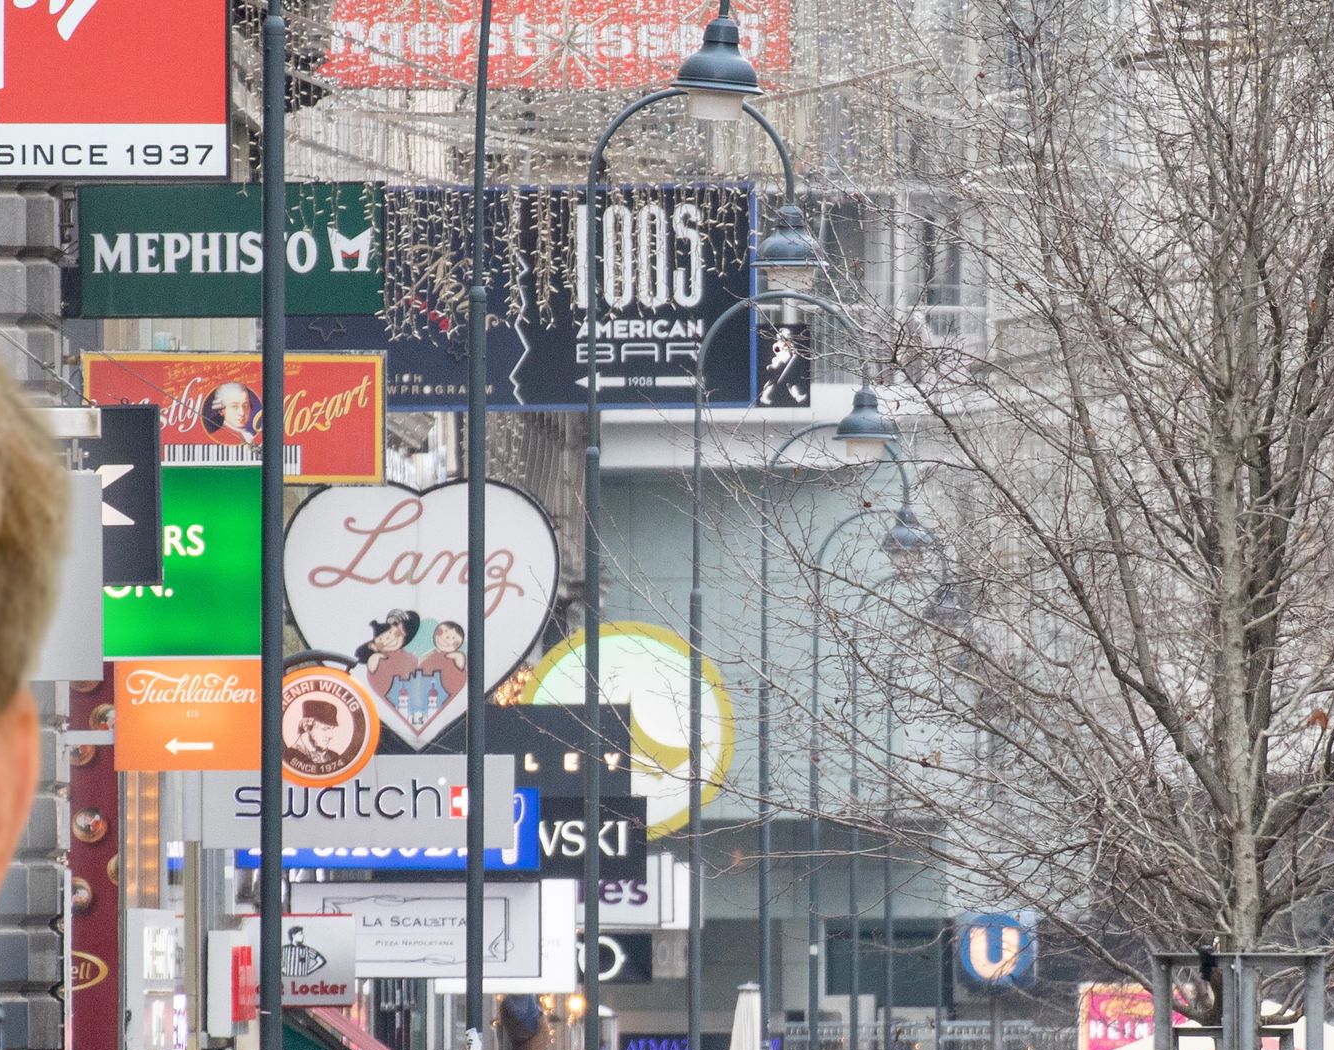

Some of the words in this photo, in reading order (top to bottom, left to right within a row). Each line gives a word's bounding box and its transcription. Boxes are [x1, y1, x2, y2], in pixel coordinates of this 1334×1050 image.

[125, 144, 213, 165] 1937
[91, 230, 317, 274] MEPHISO
[576, 319, 704, 339] AMERICAN
[576, 342, 704, 363] BAR
[627, 376, 654, 387] 1908
[307, 498, 525, 622] Lanz
[125, 669, 257, 705] Tuchlauben
[319, 681, 360, 712] WILLIG
[186, 708, 200, 718] EIS
[289, 757, 317, 774] SINCE
[319, 759, 344, 773] 1974
[235, 778, 441, 819] swatch
[362, 916, 383, 927] LA
[969, 926, 1018, 980] U
[291, 981, 348, 996] Locker
